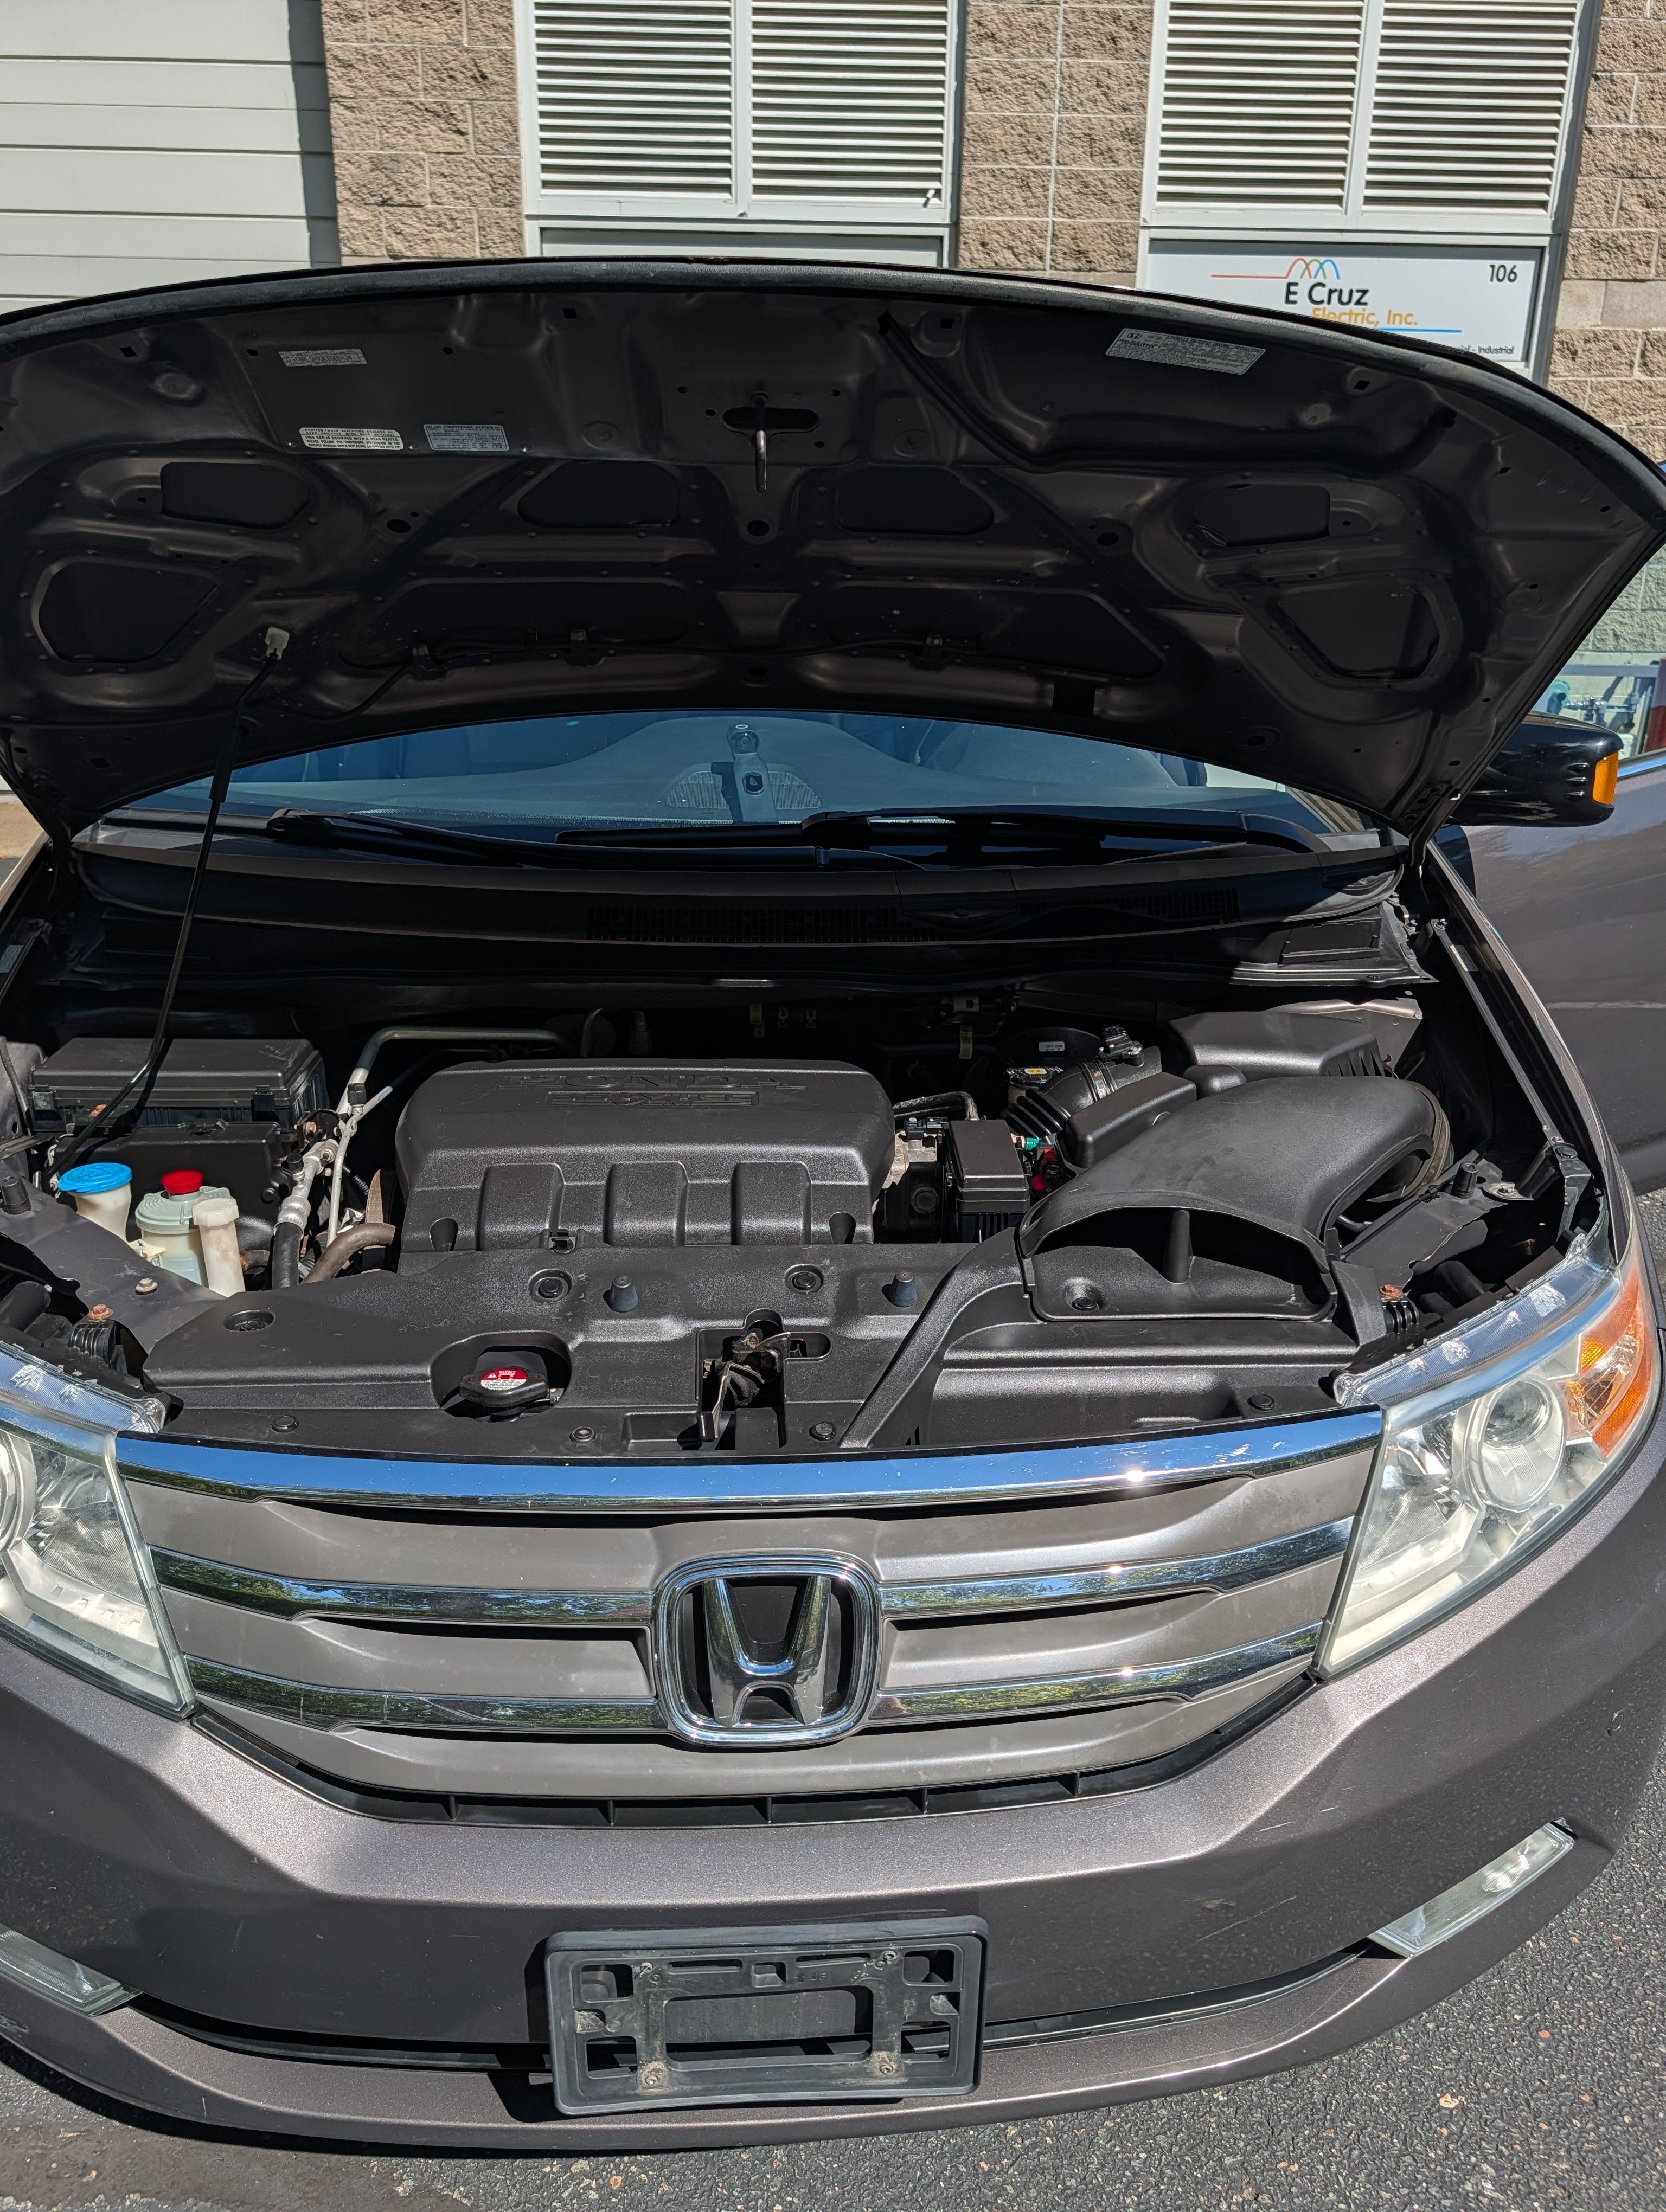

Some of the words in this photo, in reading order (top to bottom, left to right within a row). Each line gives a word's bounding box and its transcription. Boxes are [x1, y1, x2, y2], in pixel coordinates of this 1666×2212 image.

[1489, 264, 1517, 283] 106
[1284, 281, 1299, 305] E
[1307, 281, 1370, 306] Cruz
[1386, 309, 1418, 326] Inc.
[1477, 345, 1515, 355] Industrial
[498, 1075, 806, 1090] HONDA
